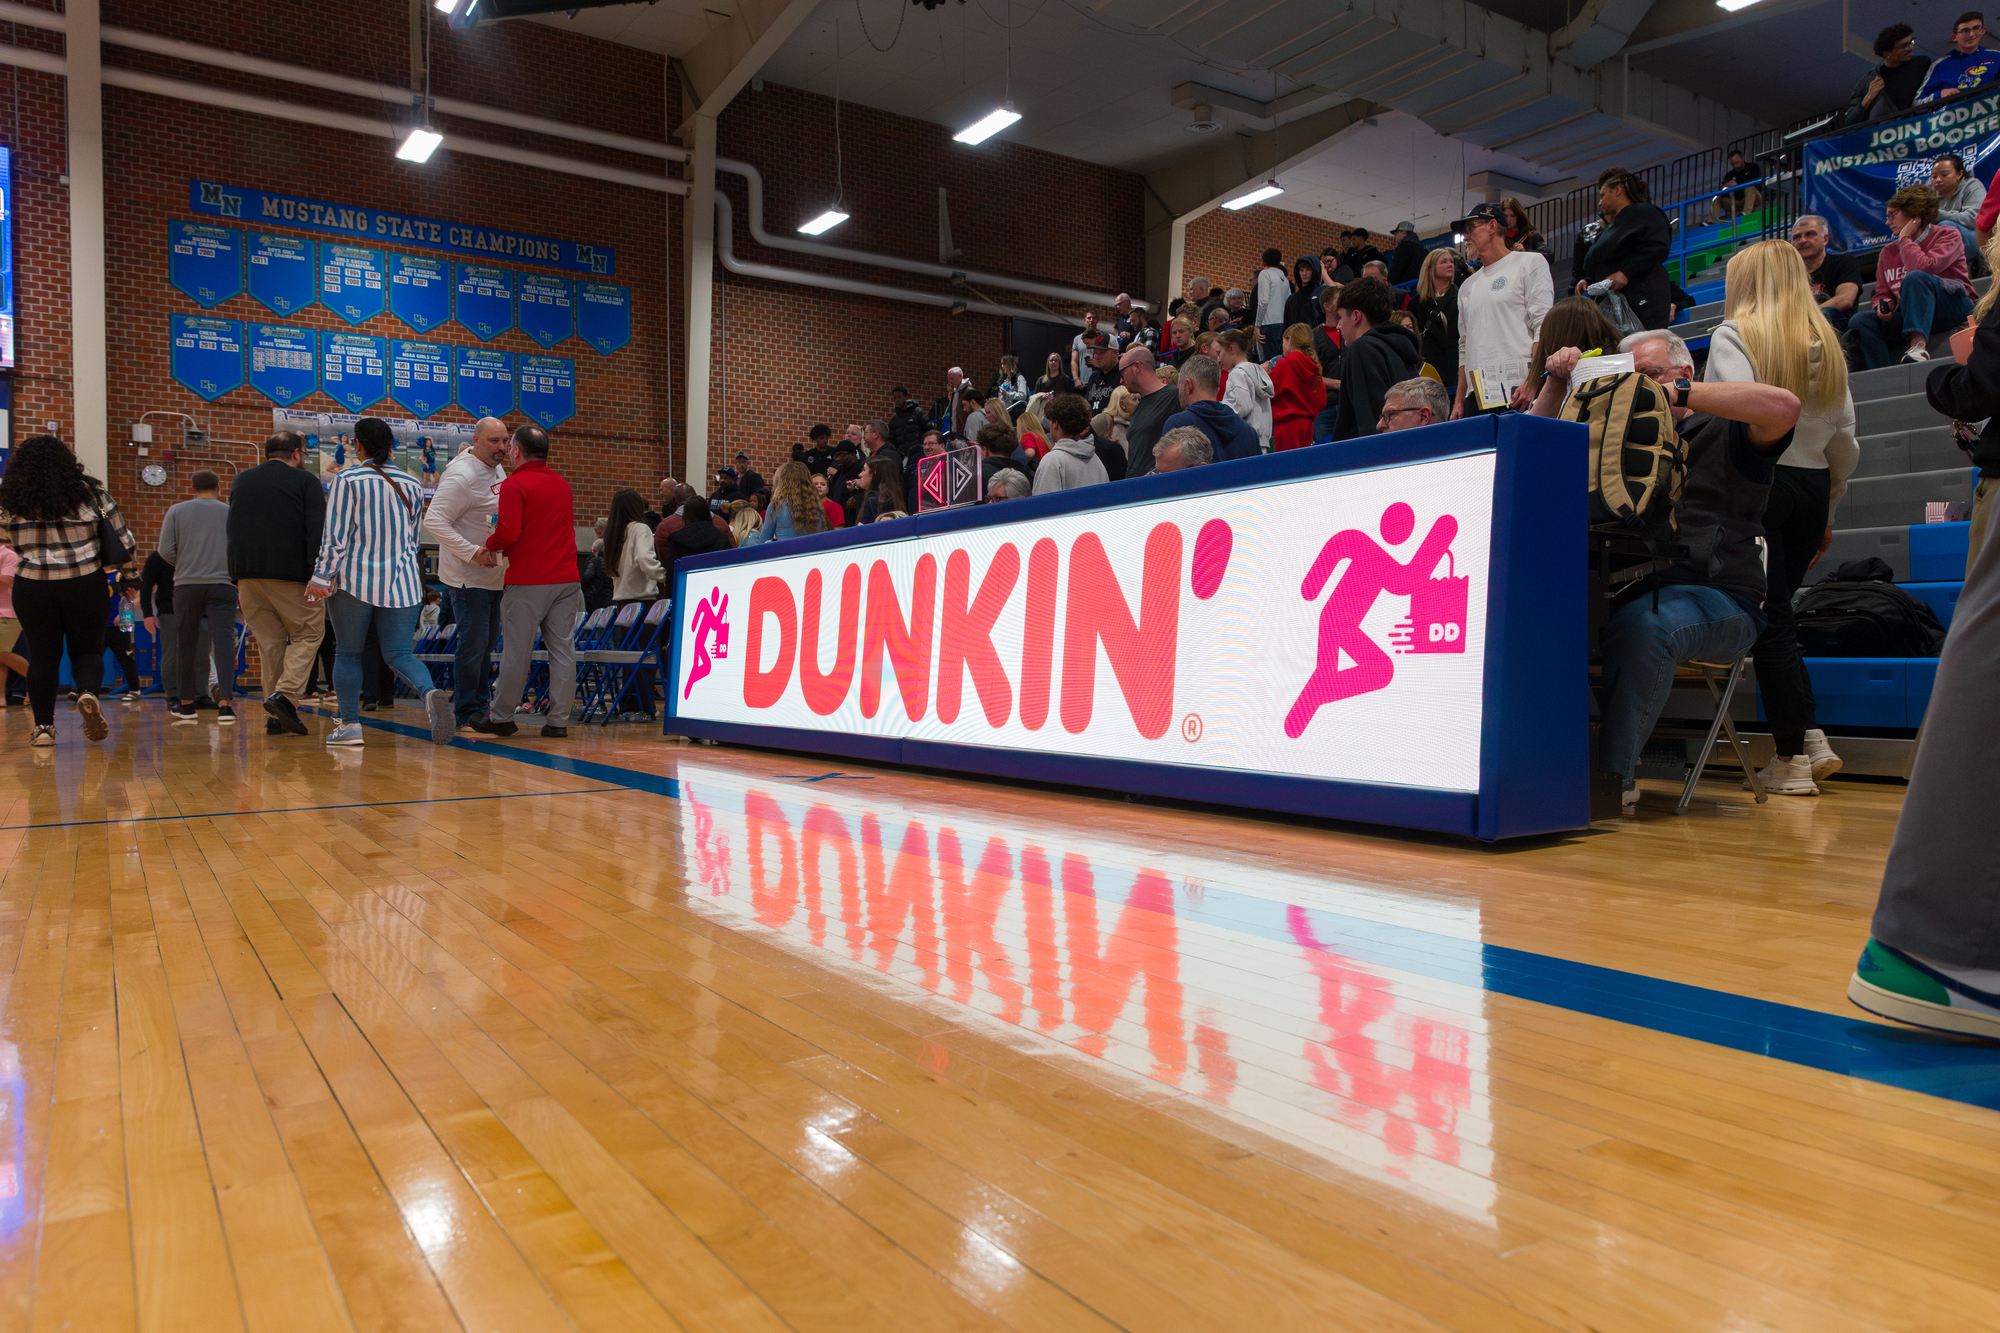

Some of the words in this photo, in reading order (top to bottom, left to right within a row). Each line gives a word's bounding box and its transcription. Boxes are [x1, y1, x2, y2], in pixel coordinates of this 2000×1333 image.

[1870, 121, 1922, 147] JOIN
[1927, 94, 2000, 131] TODAY
[1814, 143, 1909, 175] MUSTANG
[1915, 114, 2000, 152] BOOSTE
[200, 182, 242, 217] MN
[262, 196, 368, 232] MUSTANG
[376, 214, 442, 243] STATE
[450, 227, 560, 262] CHAMPIONS
[192, 236, 219, 244] BASEBALL
[199, 242, 231, 250] CHAMPIONS
[253, 256, 267, 264] 2011
[274, 252, 304, 260] CHAMPIONS
[576, 244, 607, 274] MN
[346, 262, 375, 271] CHAMPIONS
[200, 334, 232, 342] CHAMPIONS
[411, 346, 442, 355] MUSTANGS
[1092, 401, 1100, 410] N
[743, 518, 1233, 741] DUNKIN'
[1429, 622, 1460, 642] DD
[720, 644, 726, 653] DD
